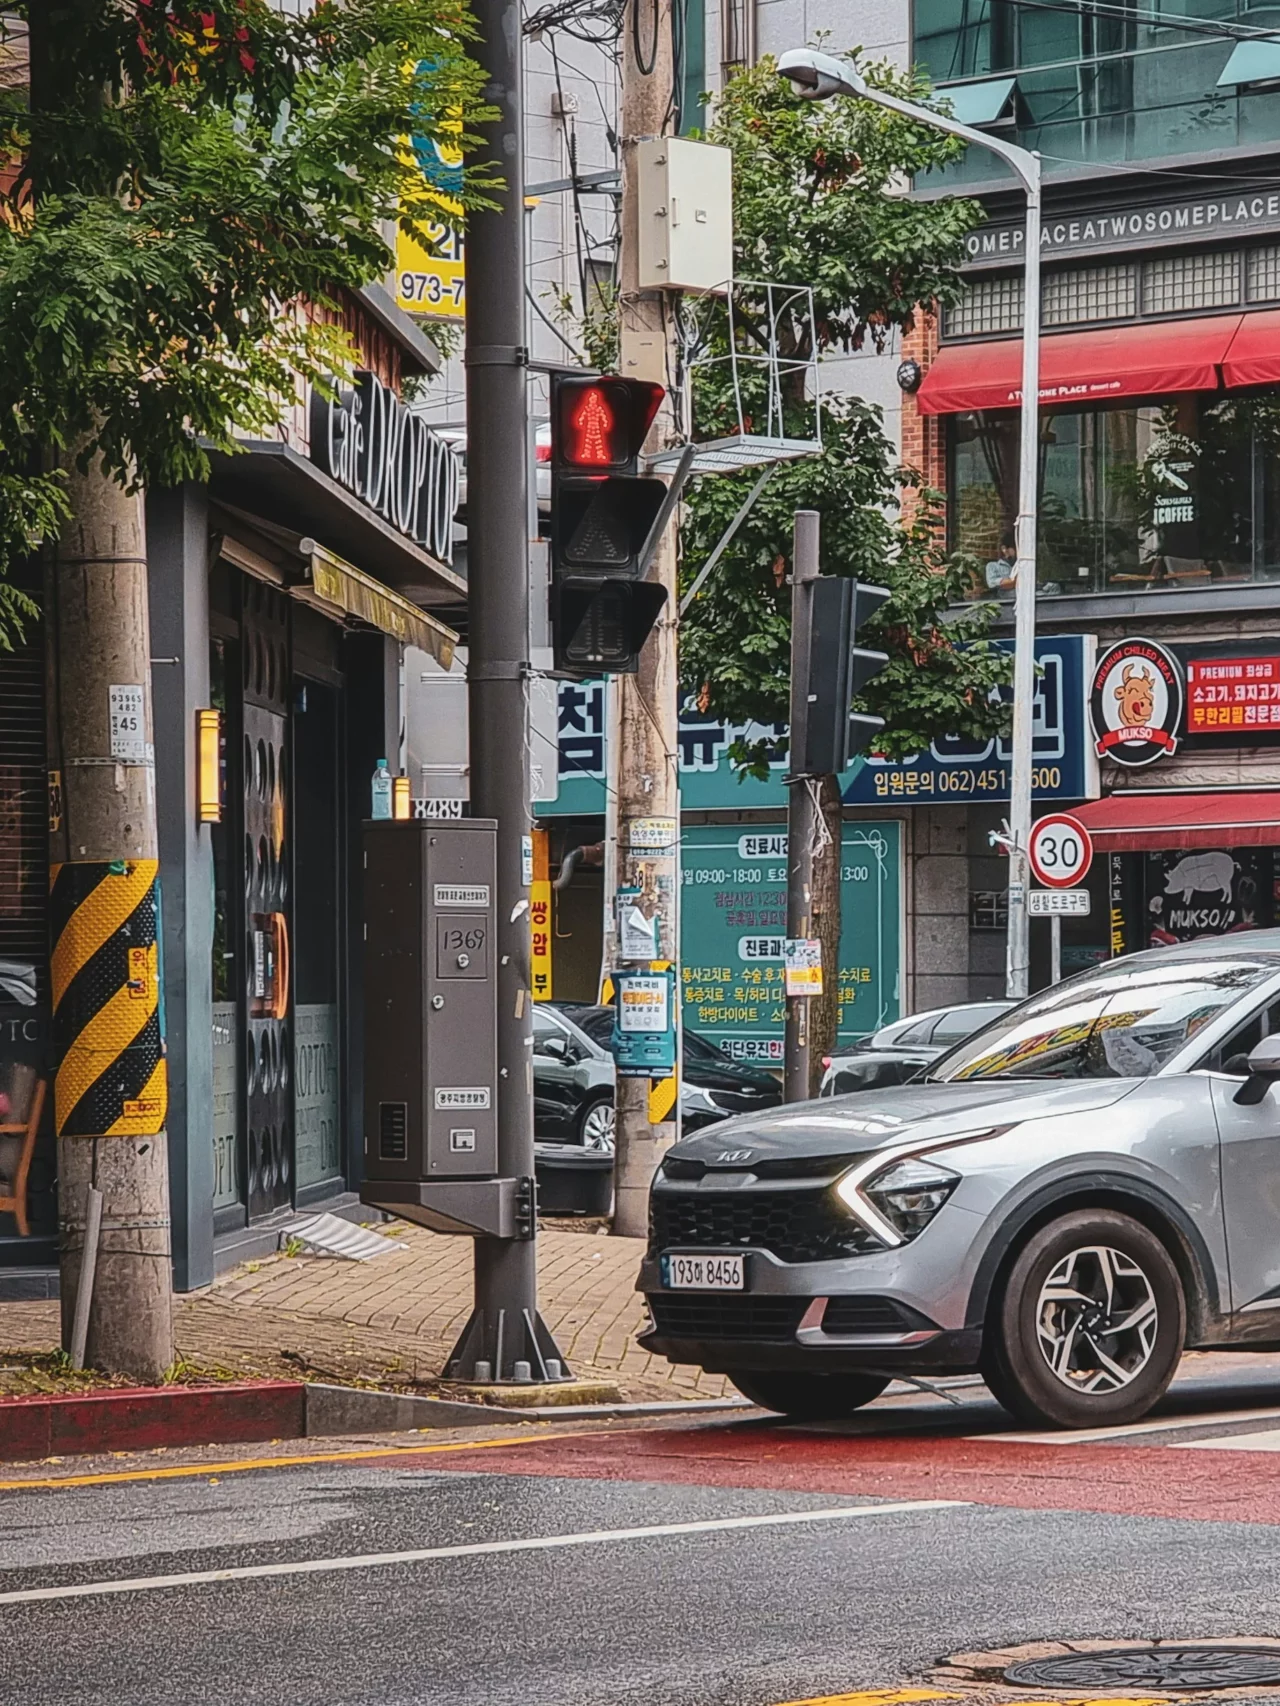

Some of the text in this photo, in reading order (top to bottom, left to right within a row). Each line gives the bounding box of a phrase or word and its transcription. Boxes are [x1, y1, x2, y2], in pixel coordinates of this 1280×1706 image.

[1200, 665, 1243, 680] PREMIUM
[119, 716, 138, 731] 45
[1118, 727, 1153, 740] MUKSO
[874, 769, 935, 796] 입원문의
[1040, 837, 1078, 868] 30
[695, 868, 762, 884] 09:00~18:00
[1169, 909, 1221, 930] MUKSO
[443, 929, 486, 950] 1369
[698, 1006, 760, 1024] 한방다이어트
[706, 1260, 741, 1286] 8456
